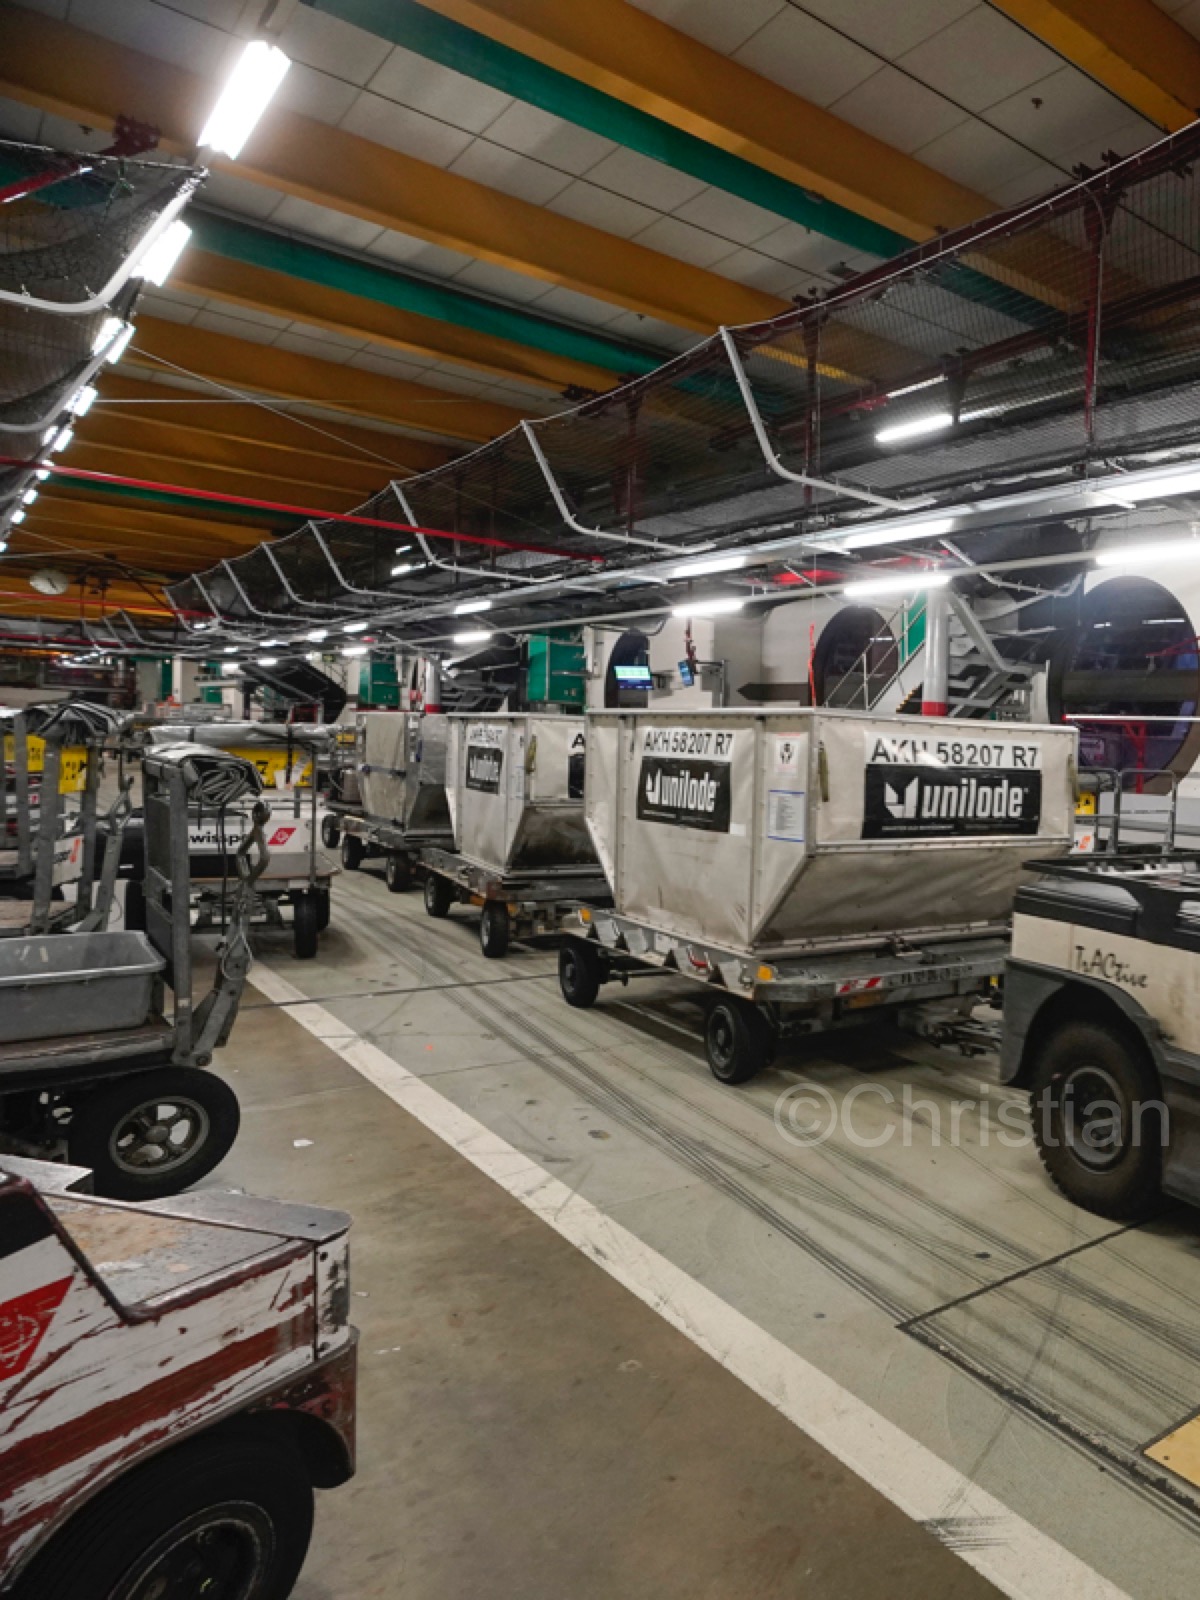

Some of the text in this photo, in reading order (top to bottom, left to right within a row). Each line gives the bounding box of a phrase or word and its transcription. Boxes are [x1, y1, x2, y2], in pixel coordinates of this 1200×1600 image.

[714, 733, 733, 755] R7
[935, 741, 1005, 766] 58207
[1011, 745, 1039, 767] R7
[661, 770, 717, 812] unilode
[921, 777, 1024, 818] unilode
